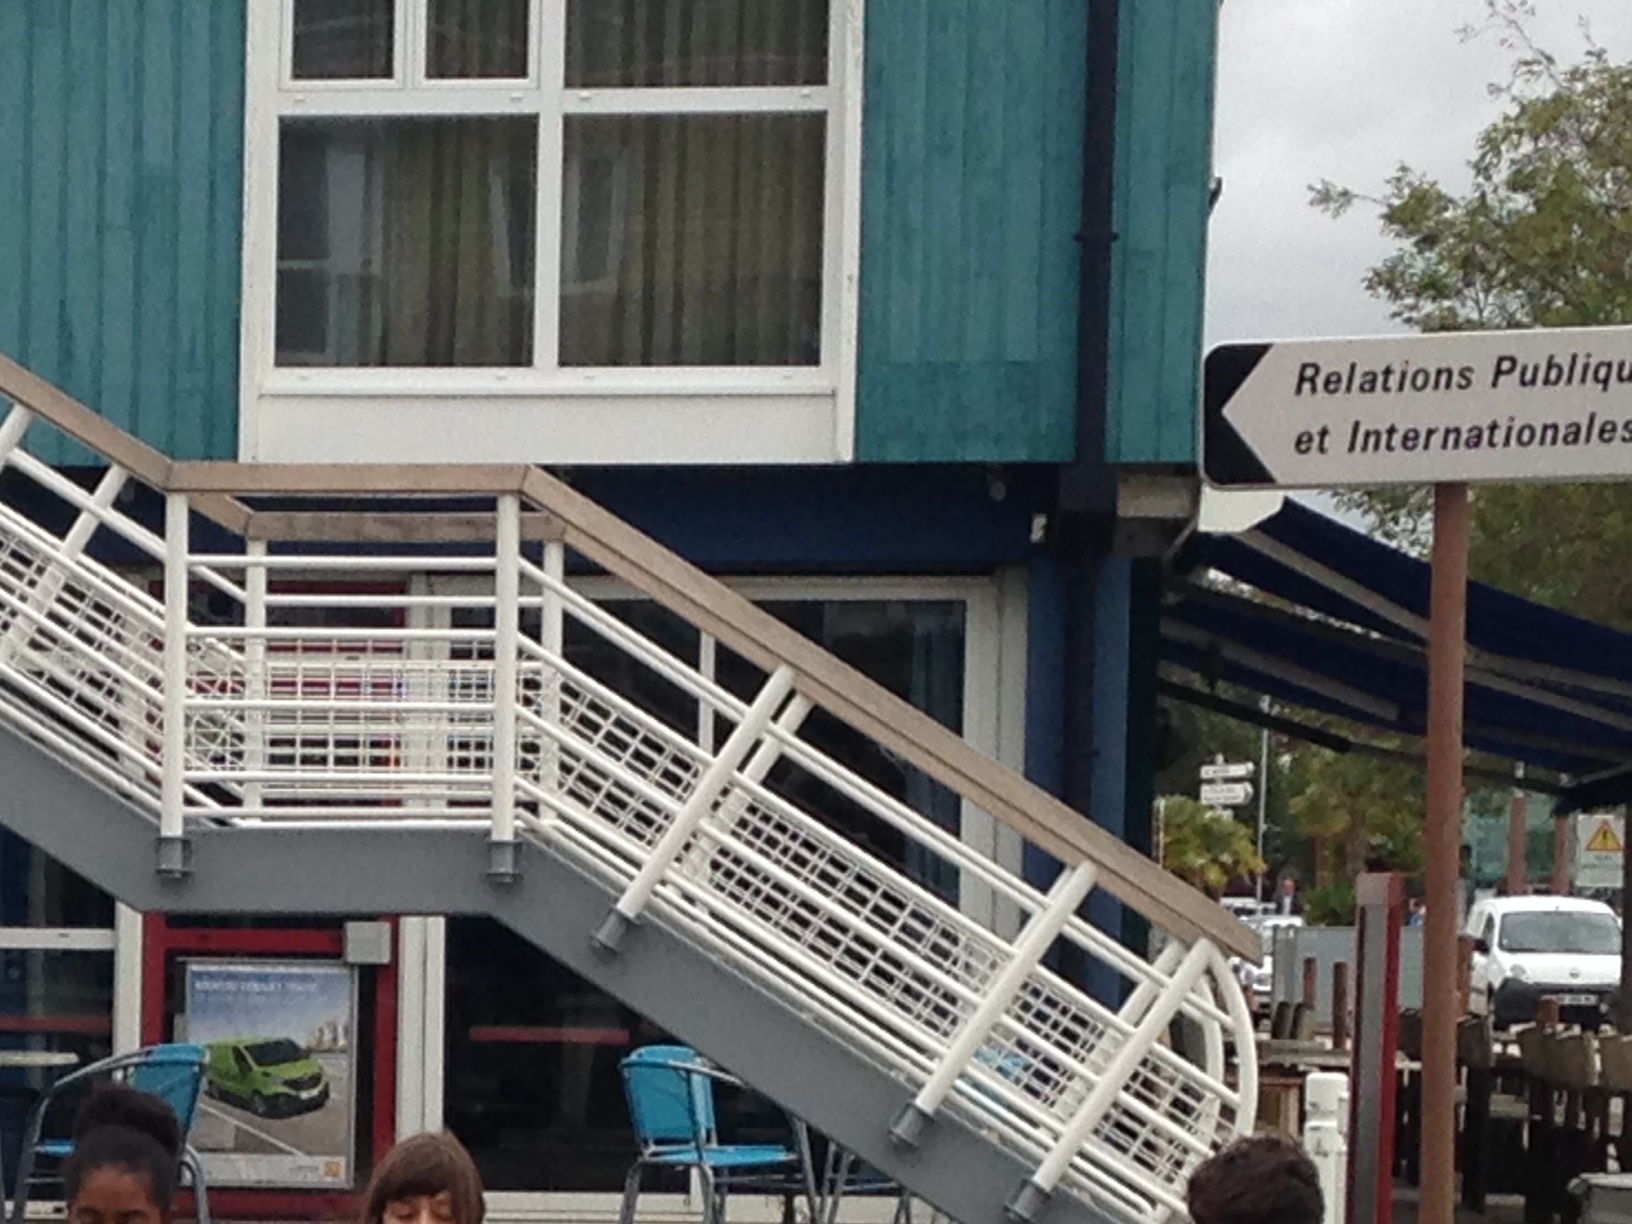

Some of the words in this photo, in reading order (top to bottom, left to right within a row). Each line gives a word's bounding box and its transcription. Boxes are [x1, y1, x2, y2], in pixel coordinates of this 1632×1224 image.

[1295, 360, 1475, 396] Relations
[1294, 425, 1330, 454] et
[1347, 412, 1632, 453] Internationales
